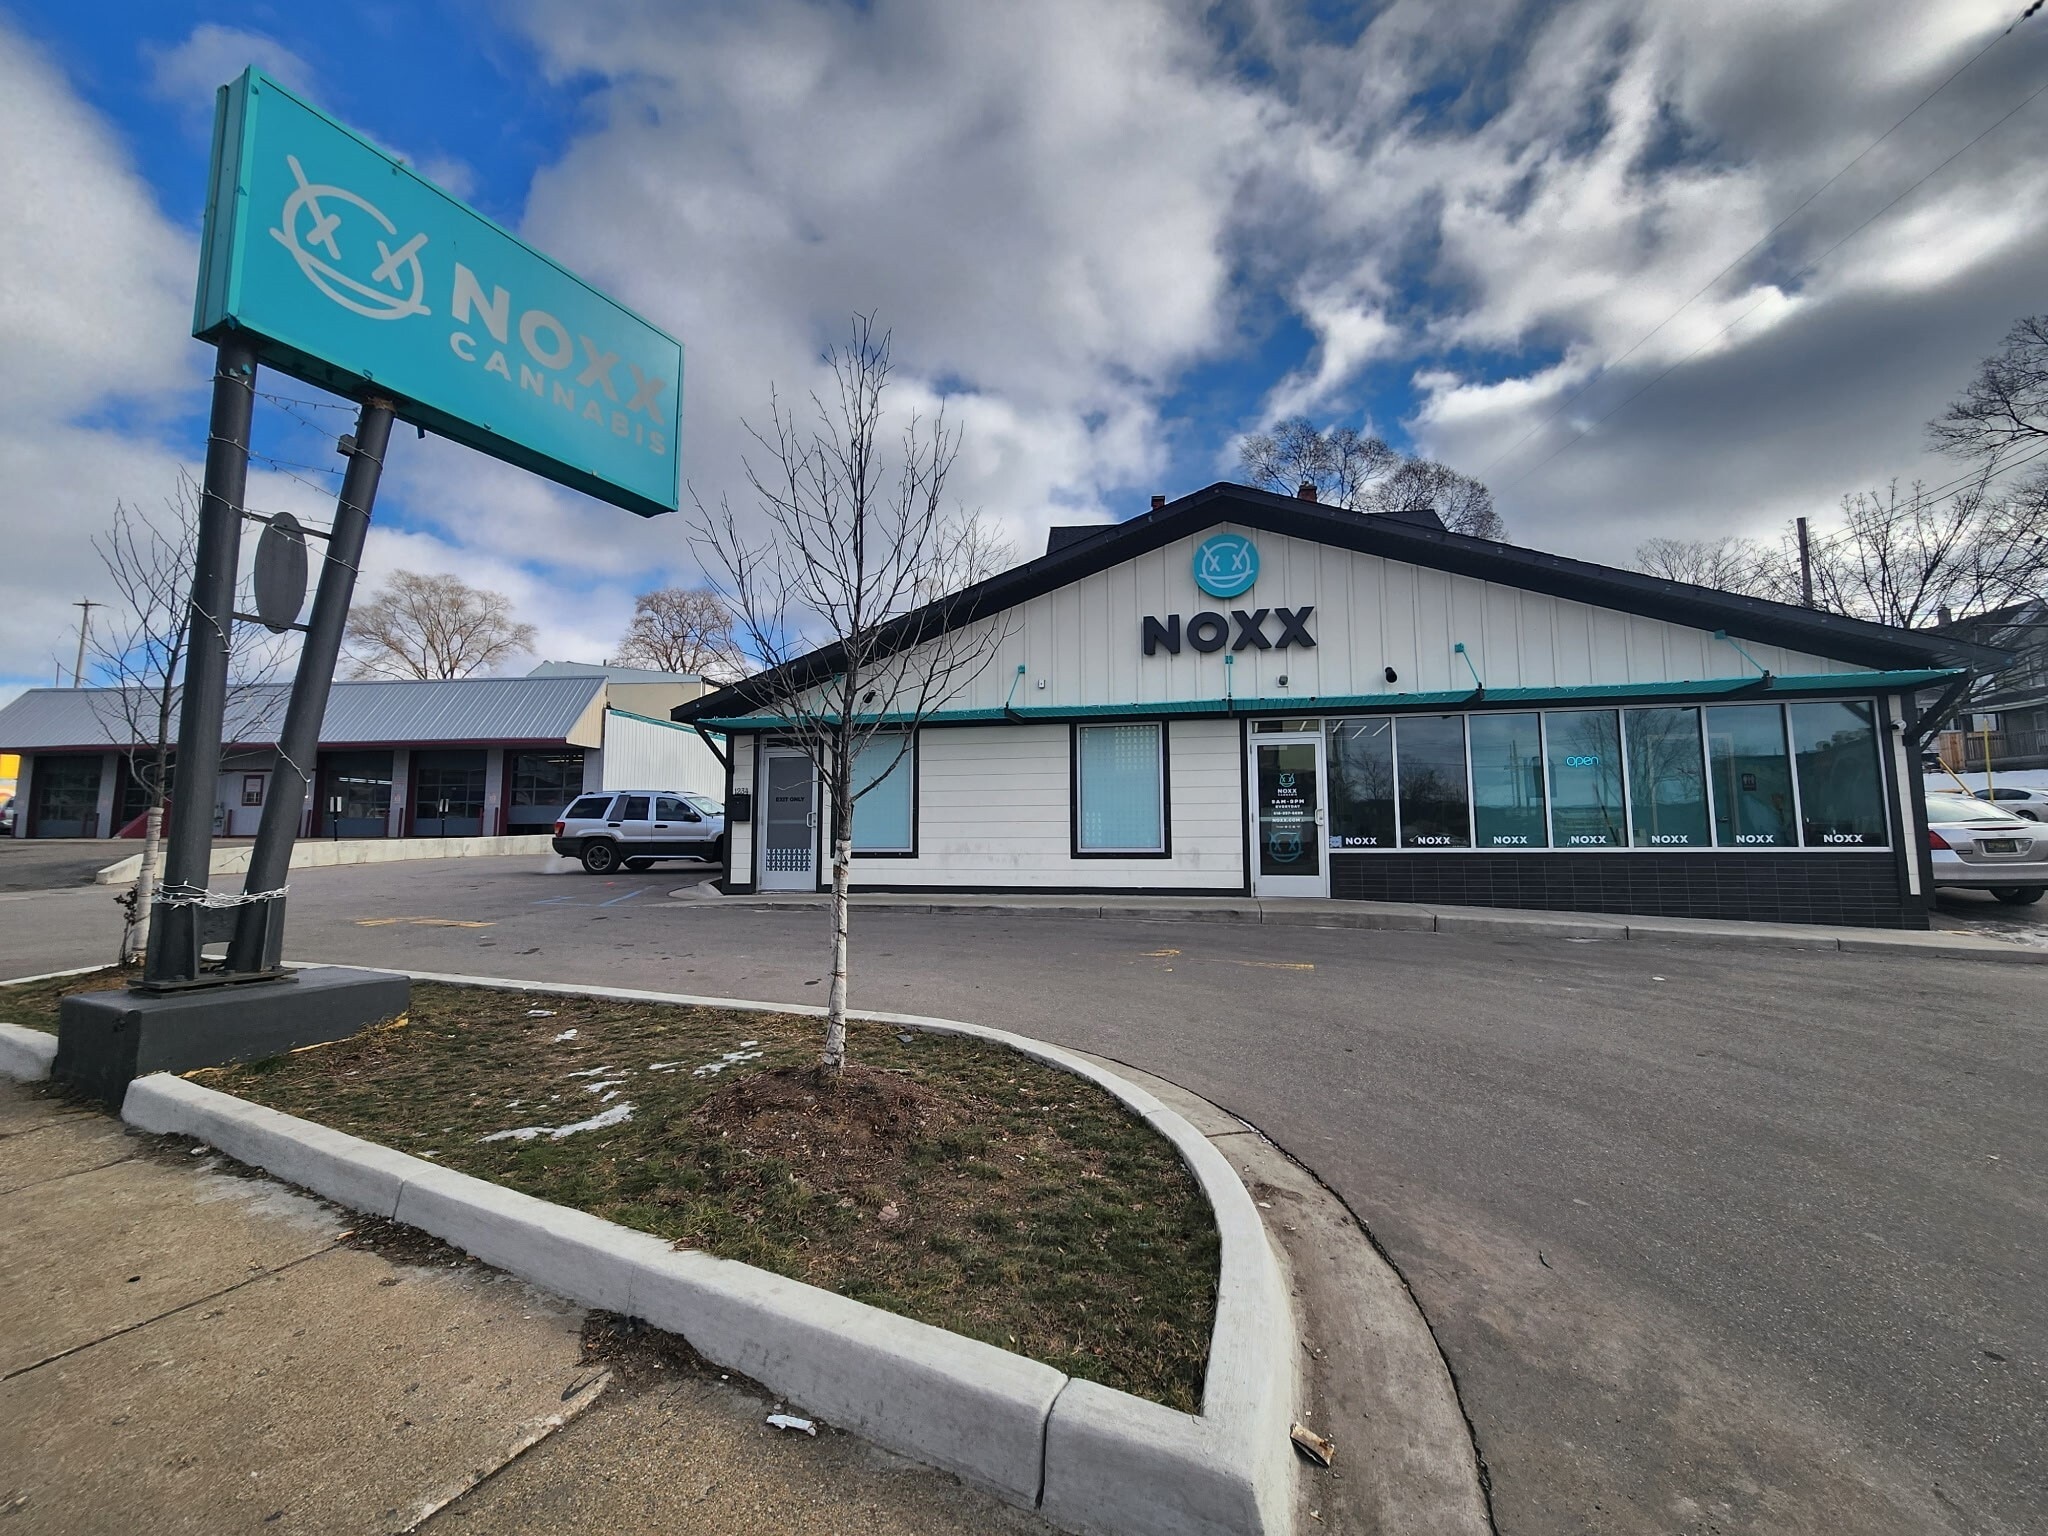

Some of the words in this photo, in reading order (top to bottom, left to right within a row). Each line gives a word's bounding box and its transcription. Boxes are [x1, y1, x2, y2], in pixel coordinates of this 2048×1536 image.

[451, 261, 667, 426] NOXX
[449, 331, 666, 456] CANNABIS
[1143, 606, 1317, 656] NOXX
[1566, 756, 1599, 768] open
[1345, 837, 1377, 845] NOXX
[1417, 836, 1451, 845] NOXX
[1493, 835, 1528, 844] NOXX
[1570, 835, 1607, 844] NOXX
[1651, 834, 1689, 844] NOXX
[1736, 834, 1775, 843] NOXX
[1823, 834, 1864, 843] NOXX
